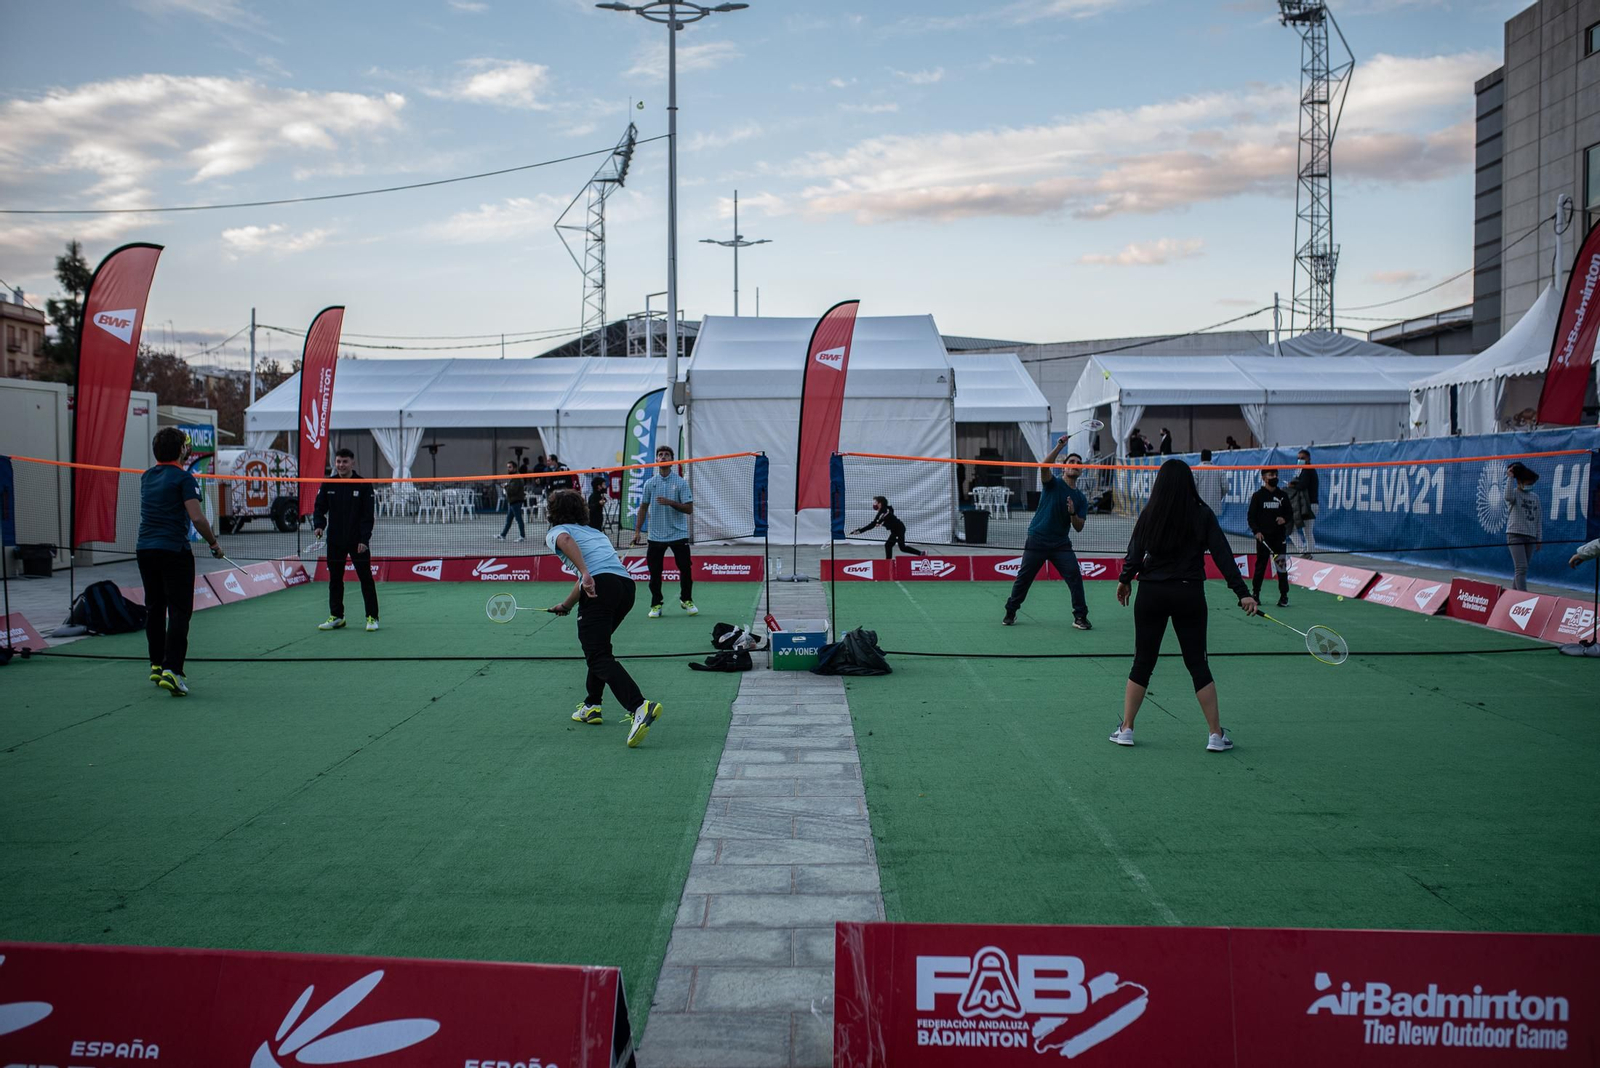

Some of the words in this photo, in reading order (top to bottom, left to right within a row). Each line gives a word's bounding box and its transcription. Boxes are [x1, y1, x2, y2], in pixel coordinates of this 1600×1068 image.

[98, 314, 131, 329] BWF
[819, 353, 842, 362] BWF
[320, 368, 332, 437] BADMINTON
[190, 428, 213, 447] YONEX
[626, 452, 648, 518] YONEX
[480, 573, 530, 581] BADMINTON
[1511, 605, 1532, 617] BWF
[794, 647, 819, 656] YONEX
[1306, 971, 1570, 1022] AirBadminton
[978, 1018, 1030, 1031] ANDALUZA
[1363, 1018, 1396, 1044] The
[1398, 1020, 1440, 1046] New
[1441, 1021, 1514, 1048] Outdoor
[1515, 1023, 1568, 1050] Game
[70, 1038, 160, 1060] ESPAÑA
